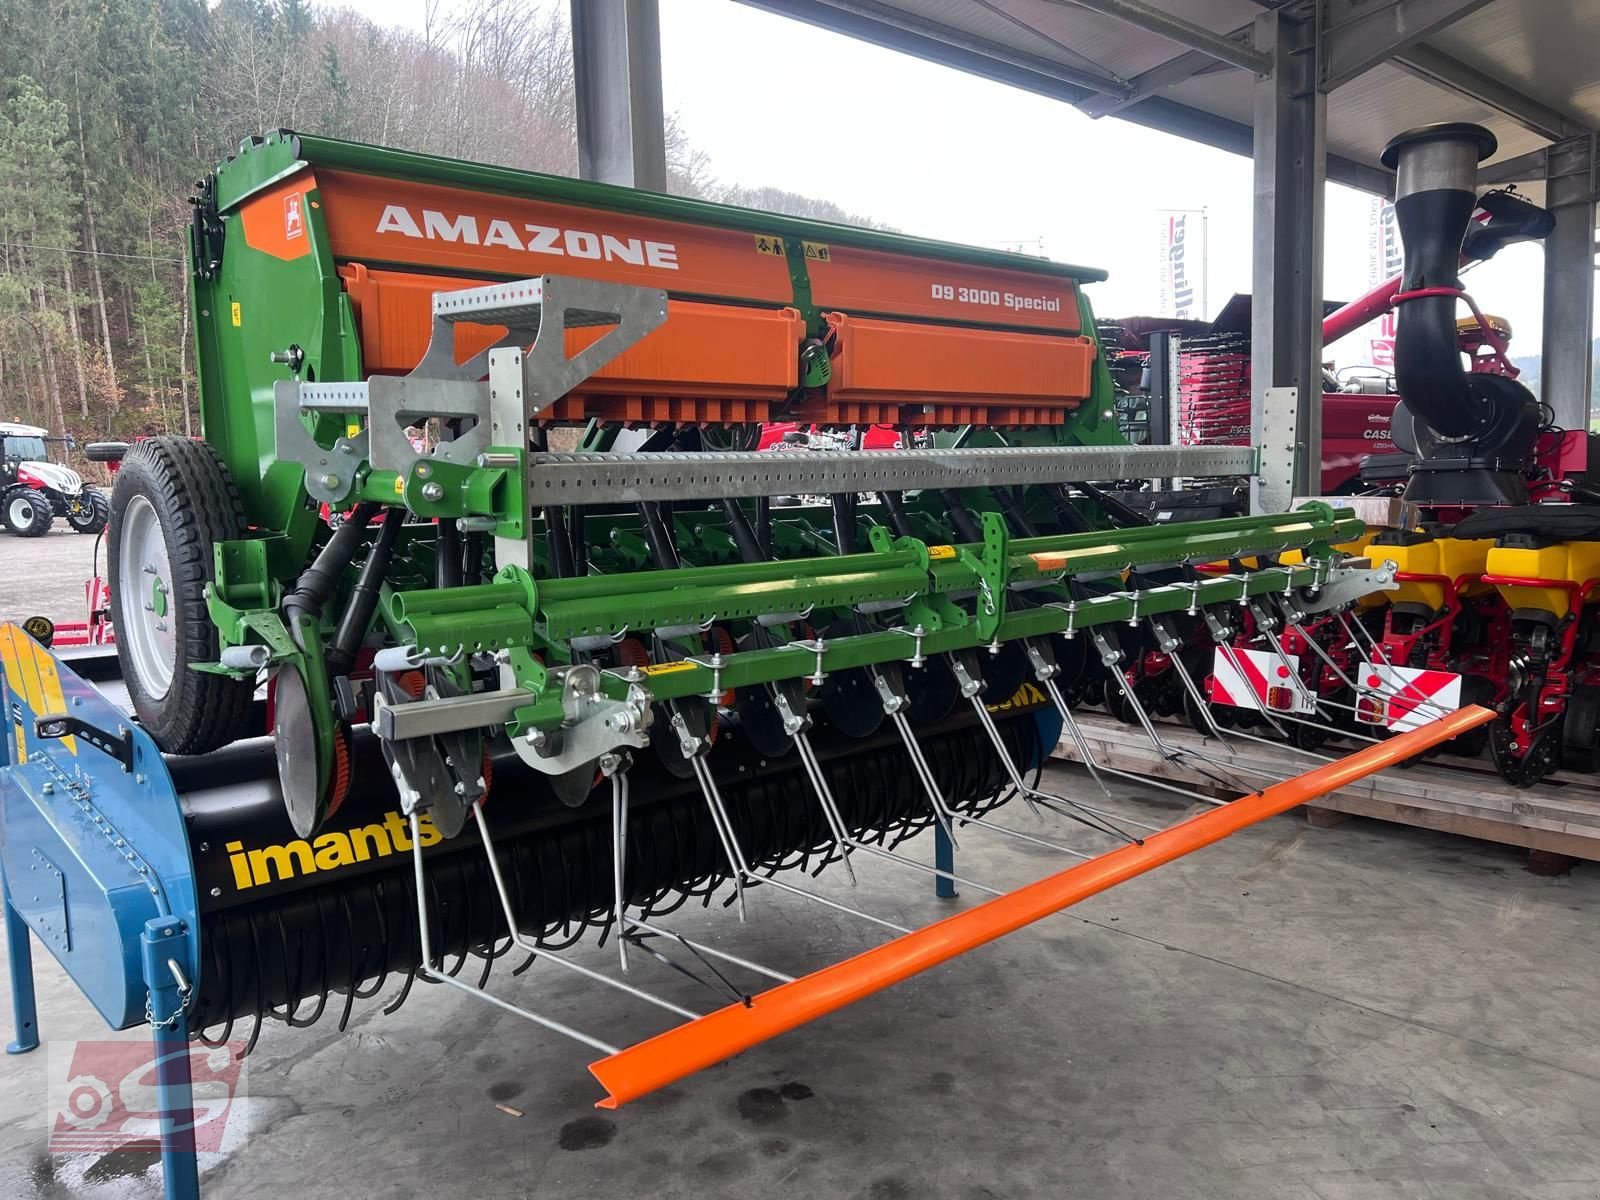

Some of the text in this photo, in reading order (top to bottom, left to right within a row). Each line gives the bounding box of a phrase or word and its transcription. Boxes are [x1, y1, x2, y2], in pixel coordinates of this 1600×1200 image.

[376, 205, 679, 270] AMAZONE
[931, 284, 1060, 312] D9 3000 Special
[225, 811, 444, 890] imants
